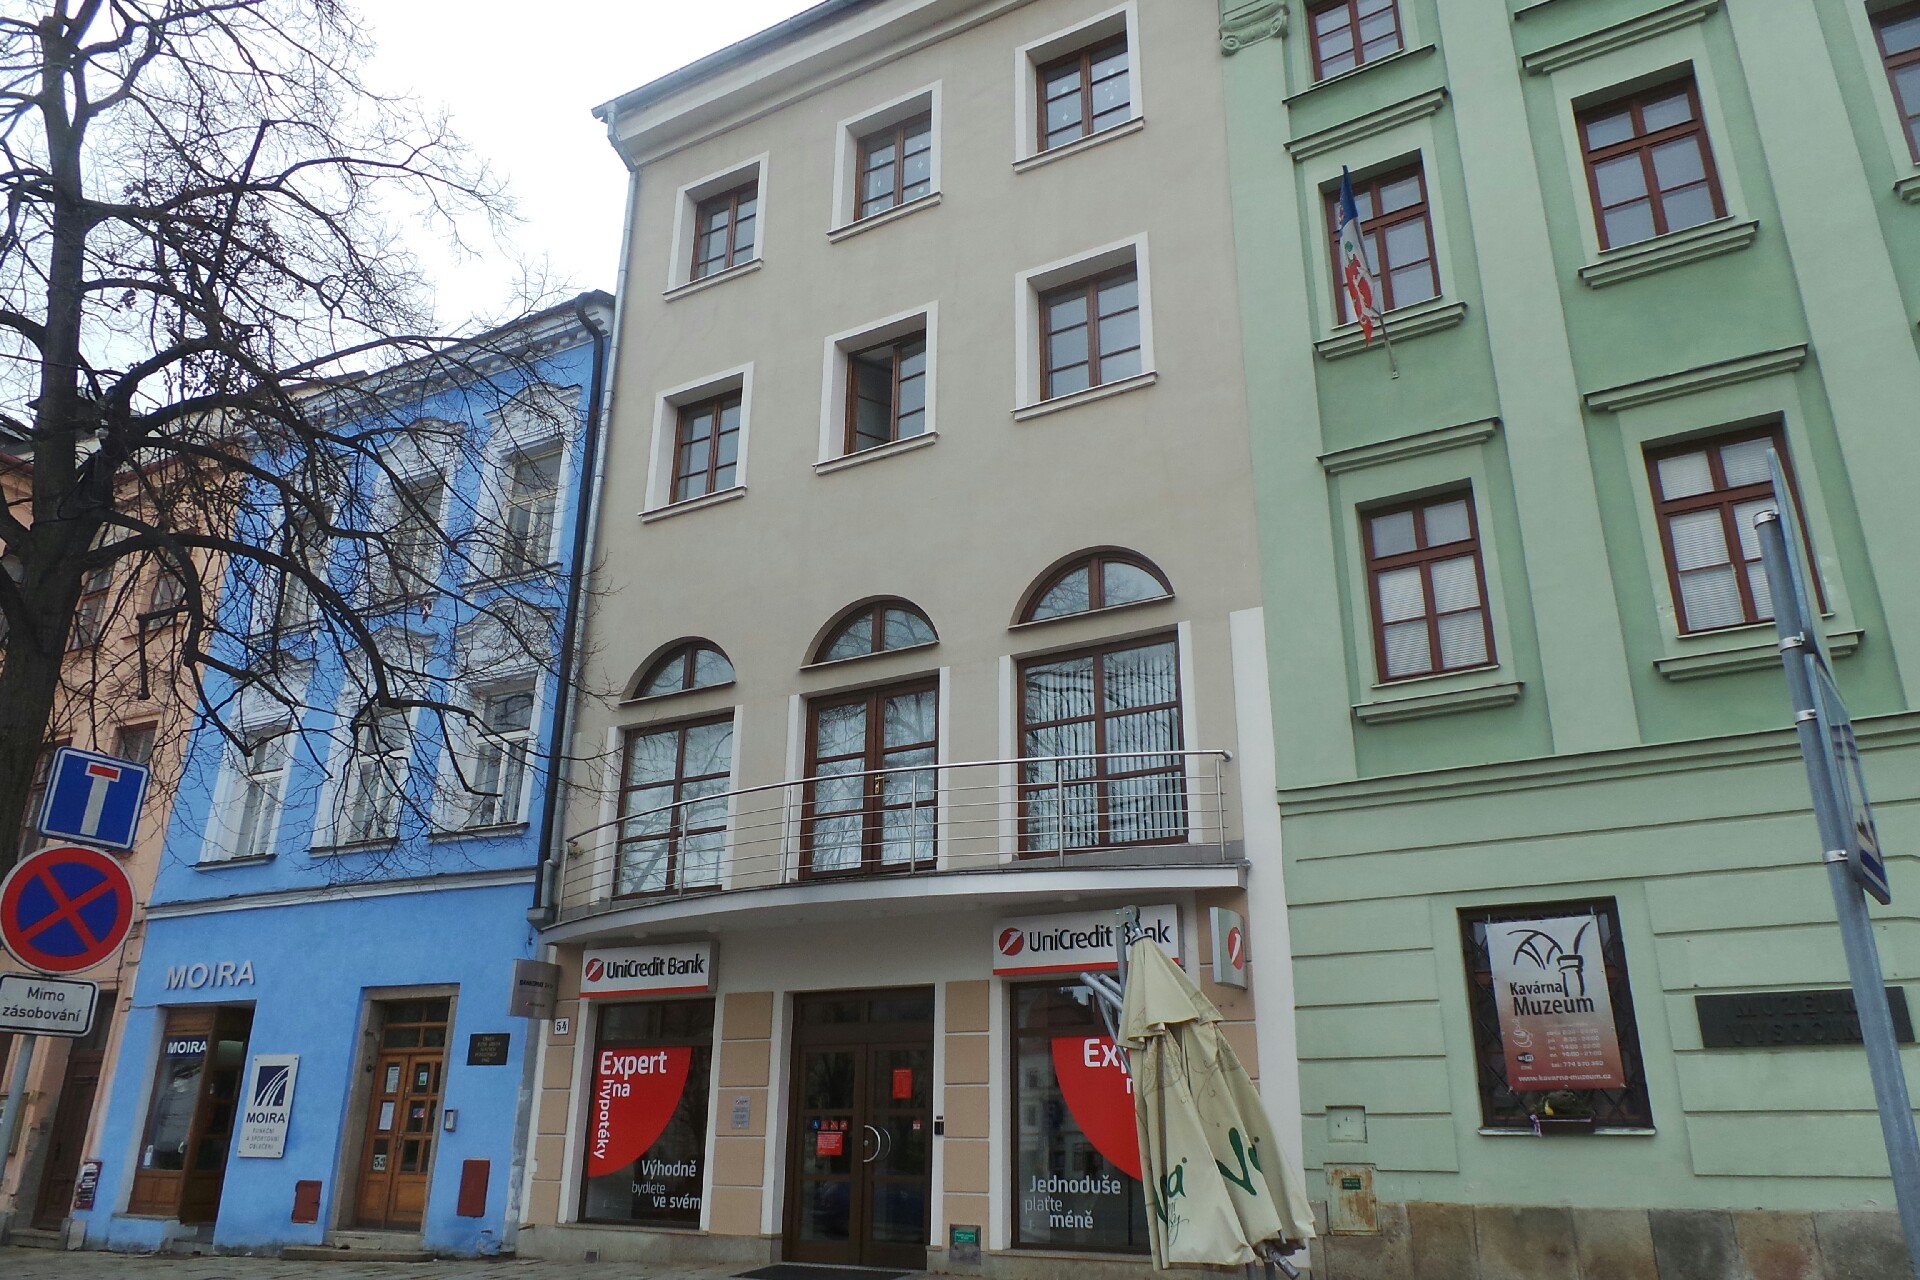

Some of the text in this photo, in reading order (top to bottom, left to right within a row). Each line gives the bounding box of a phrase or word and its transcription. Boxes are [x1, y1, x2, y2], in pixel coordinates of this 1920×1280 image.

[1029, 919, 1171, 952] UniCredit Bnk
[166, 960, 255, 990] MOIRA
[606, 953, 704, 979] UniCredit Bank
[27, 986, 65, 1002] Mimo
[1509, 980, 1563, 996] Kavárna
[2, 1004, 82, 1022] zásobování
[1513, 996, 1595, 1017] Muzeum
[556, 1021, 567, 1032] 54
[167, 1040, 207, 1054] MOIRA
[600, 1051, 668, 1081] Expert
[612, 1082, 631, 1098] na
[246, 1112, 285, 1123] MOIRA
[593, 1079, 615, 1160] hypotéky
[641, 1159, 697, 1180] Výhodně
[631, 1180, 666, 1197] bydlete
[1029, 1174, 1121, 1194] Jednoduše
[652, 1193, 701, 1210] ve svém
[1024, 1195, 1063, 1215] plaťte
[1049, 1209, 1094, 1229] méně
